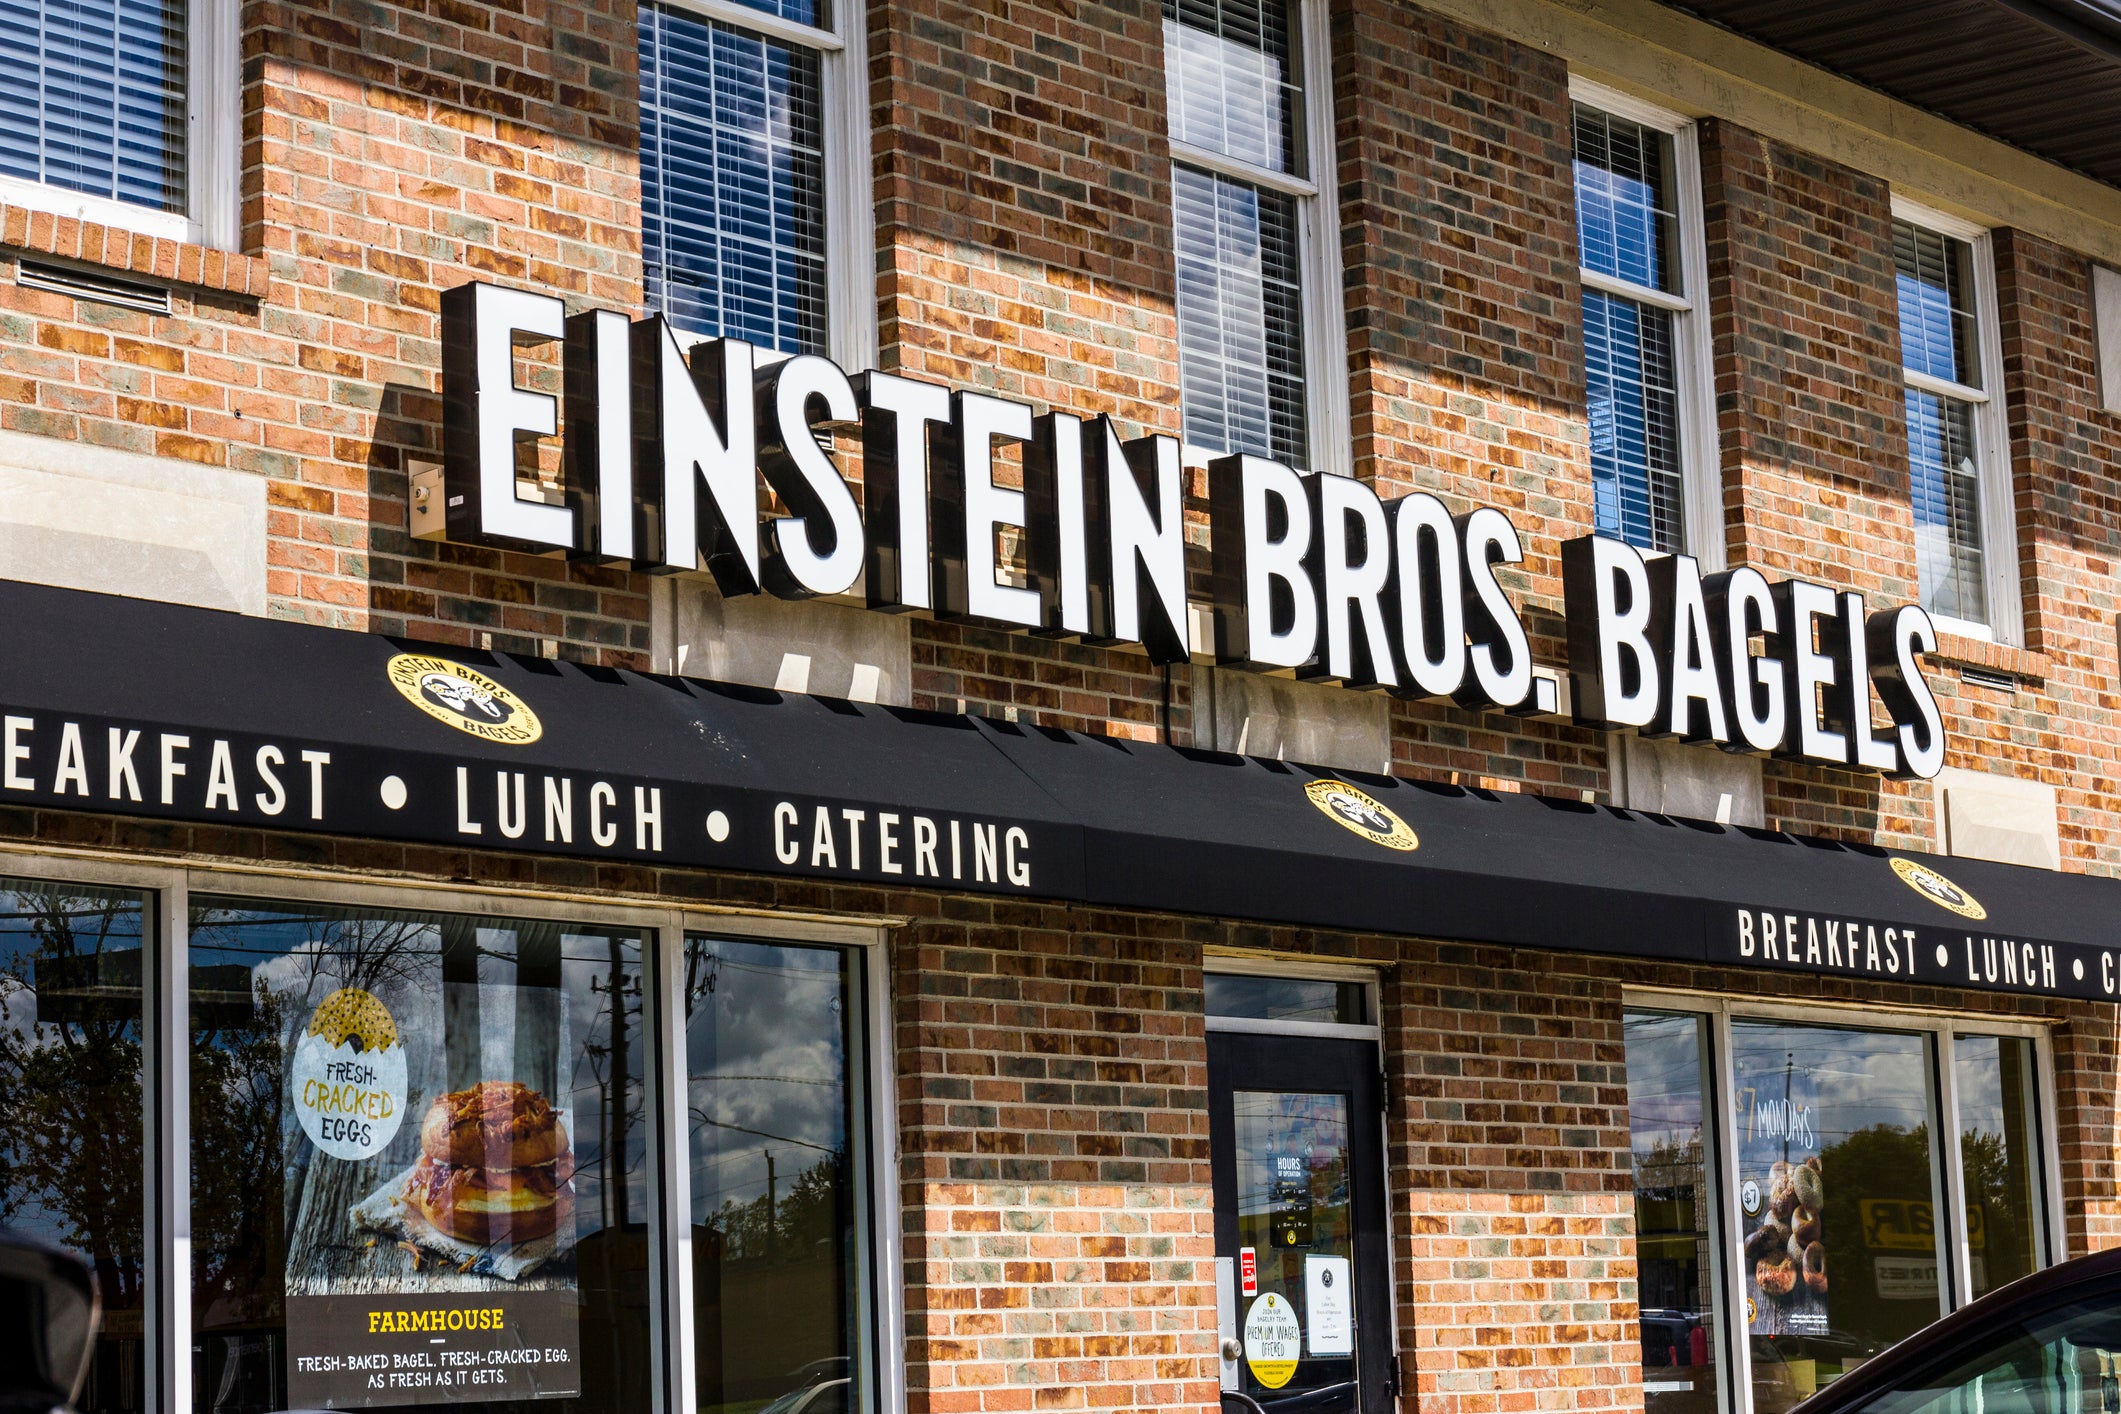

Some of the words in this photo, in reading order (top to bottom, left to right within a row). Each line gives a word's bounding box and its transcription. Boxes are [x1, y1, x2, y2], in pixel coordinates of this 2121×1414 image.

[473, 281, 1190, 664] EINSTEIN
[1240, 453, 1558, 713] BROS.
[1590, 534, 1946, 779] BAGELS
[393, 657, 449, 687] EINSTEIN
[455, 666, 511, 699] BROS
[463, 719, 532, 741] BAGELS
[4, 714, 331, 821] EAKFAST
[456, 766, 663, 852] LUNCH
[773, 801, 1031, 888] CATERING
[1737, 909, 1916, 975] BREAKFAST
[1965, 936, 2057, 989] LUNCH
[326, 1061, 377, 1086] FRESH-
[303, 1078, 394, 1120] CRACKED
[321, 1116, 372, 1147] EGGS
[1757, 1098, 1814, 1150] MONDAYS
[1277, 1157, 1301, 1170] HOURS
[368, 1308, 504, 1333] FARMHOUSE
[1276, 1325, 1299, 1341] WAGES
[297, 1354, 389, 1373] FRESH-BAKED
[393, 1352, 437, 1369] BAGEL.
[440, 1349, 541, 1367] FRESH-CRACKED
[545, 1348, 571, 1363] EGG.
[1262, 1341, 1285, 1357] OFFERED
[367, 1373, 385, 1389] AS
[390, 1371, 432, 1388] FRESH
[435, 1371, 452, 1386] AS
[456, 1370, 468, 1385] IT
[472, 1369, 508, 1384] GETS.
